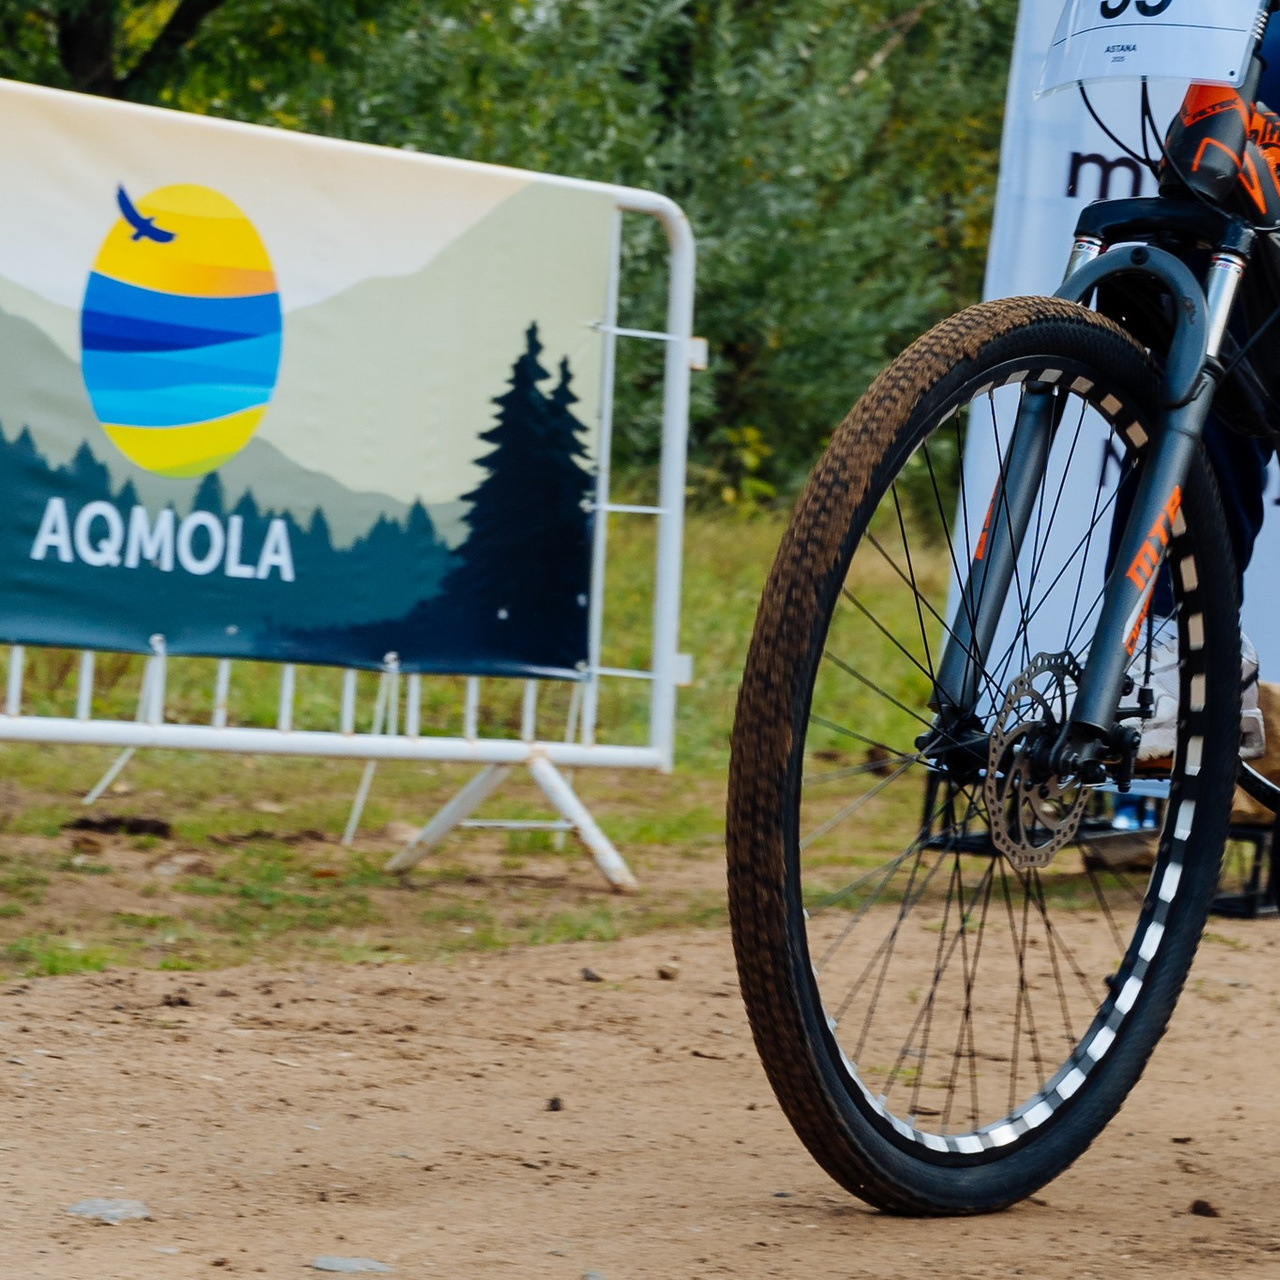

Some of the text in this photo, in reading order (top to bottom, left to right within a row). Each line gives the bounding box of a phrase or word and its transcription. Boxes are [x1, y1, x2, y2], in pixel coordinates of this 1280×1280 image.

[1104, 43, 1138, 55] ASTANA
[1066, 152, 1148, 199] m
[31, 496, 296, 583] AQMOLA
